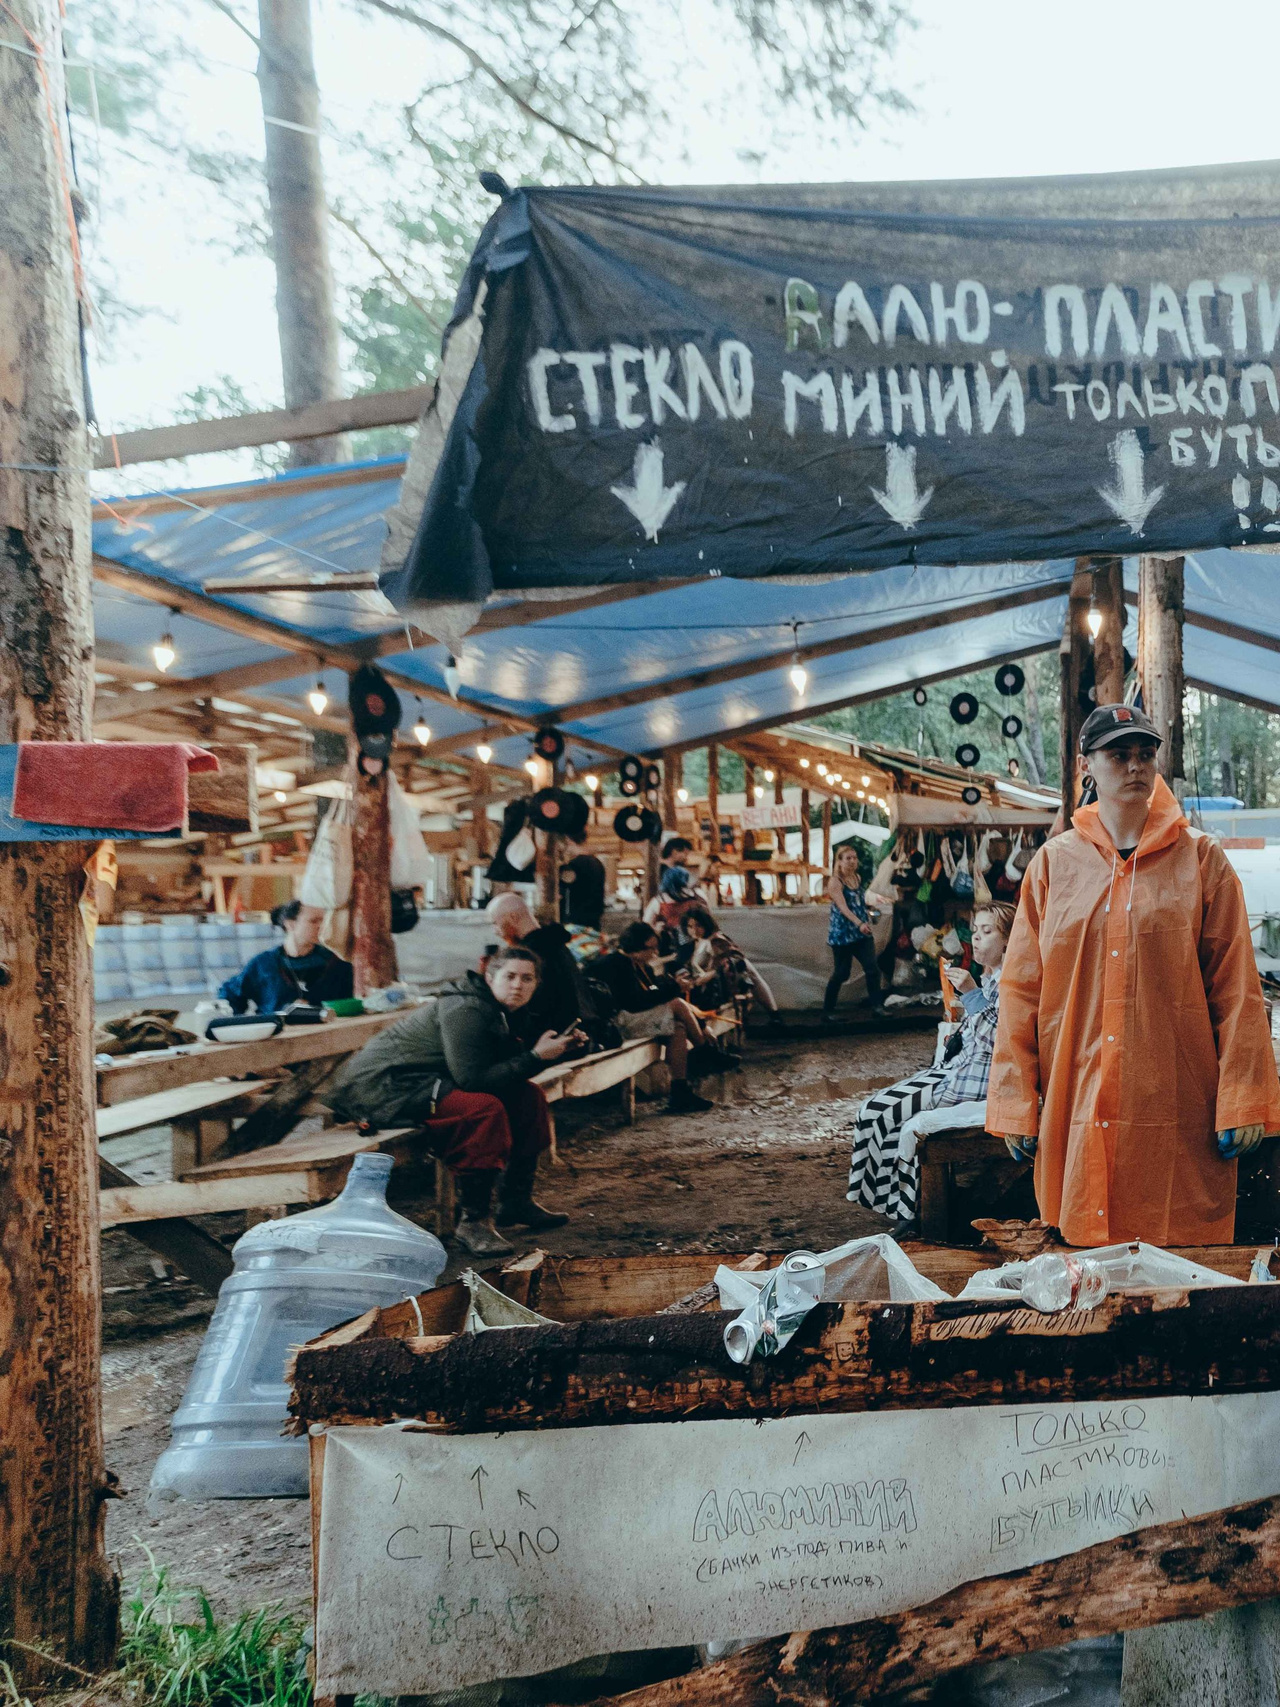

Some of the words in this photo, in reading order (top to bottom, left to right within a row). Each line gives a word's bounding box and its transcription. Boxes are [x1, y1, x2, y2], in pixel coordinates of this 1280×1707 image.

[525, 339, 756, 434] СТЕКЛО
[780, 347, 1027, 438] МИНИЙ
[1053, 373, 1229, 421] ТОЛЬКО
[1000, 1404, 1147, 1448] ТОЛЬКО
[692, 1478, 918, 1543] АЛЮМИНИЙ
[990, 1484, 1156, 1554] БУТЫЛКИ
[386, 1524, 560, 1567] СТЕКЛО
[838, 1538, 888, 1555] ПИВА
